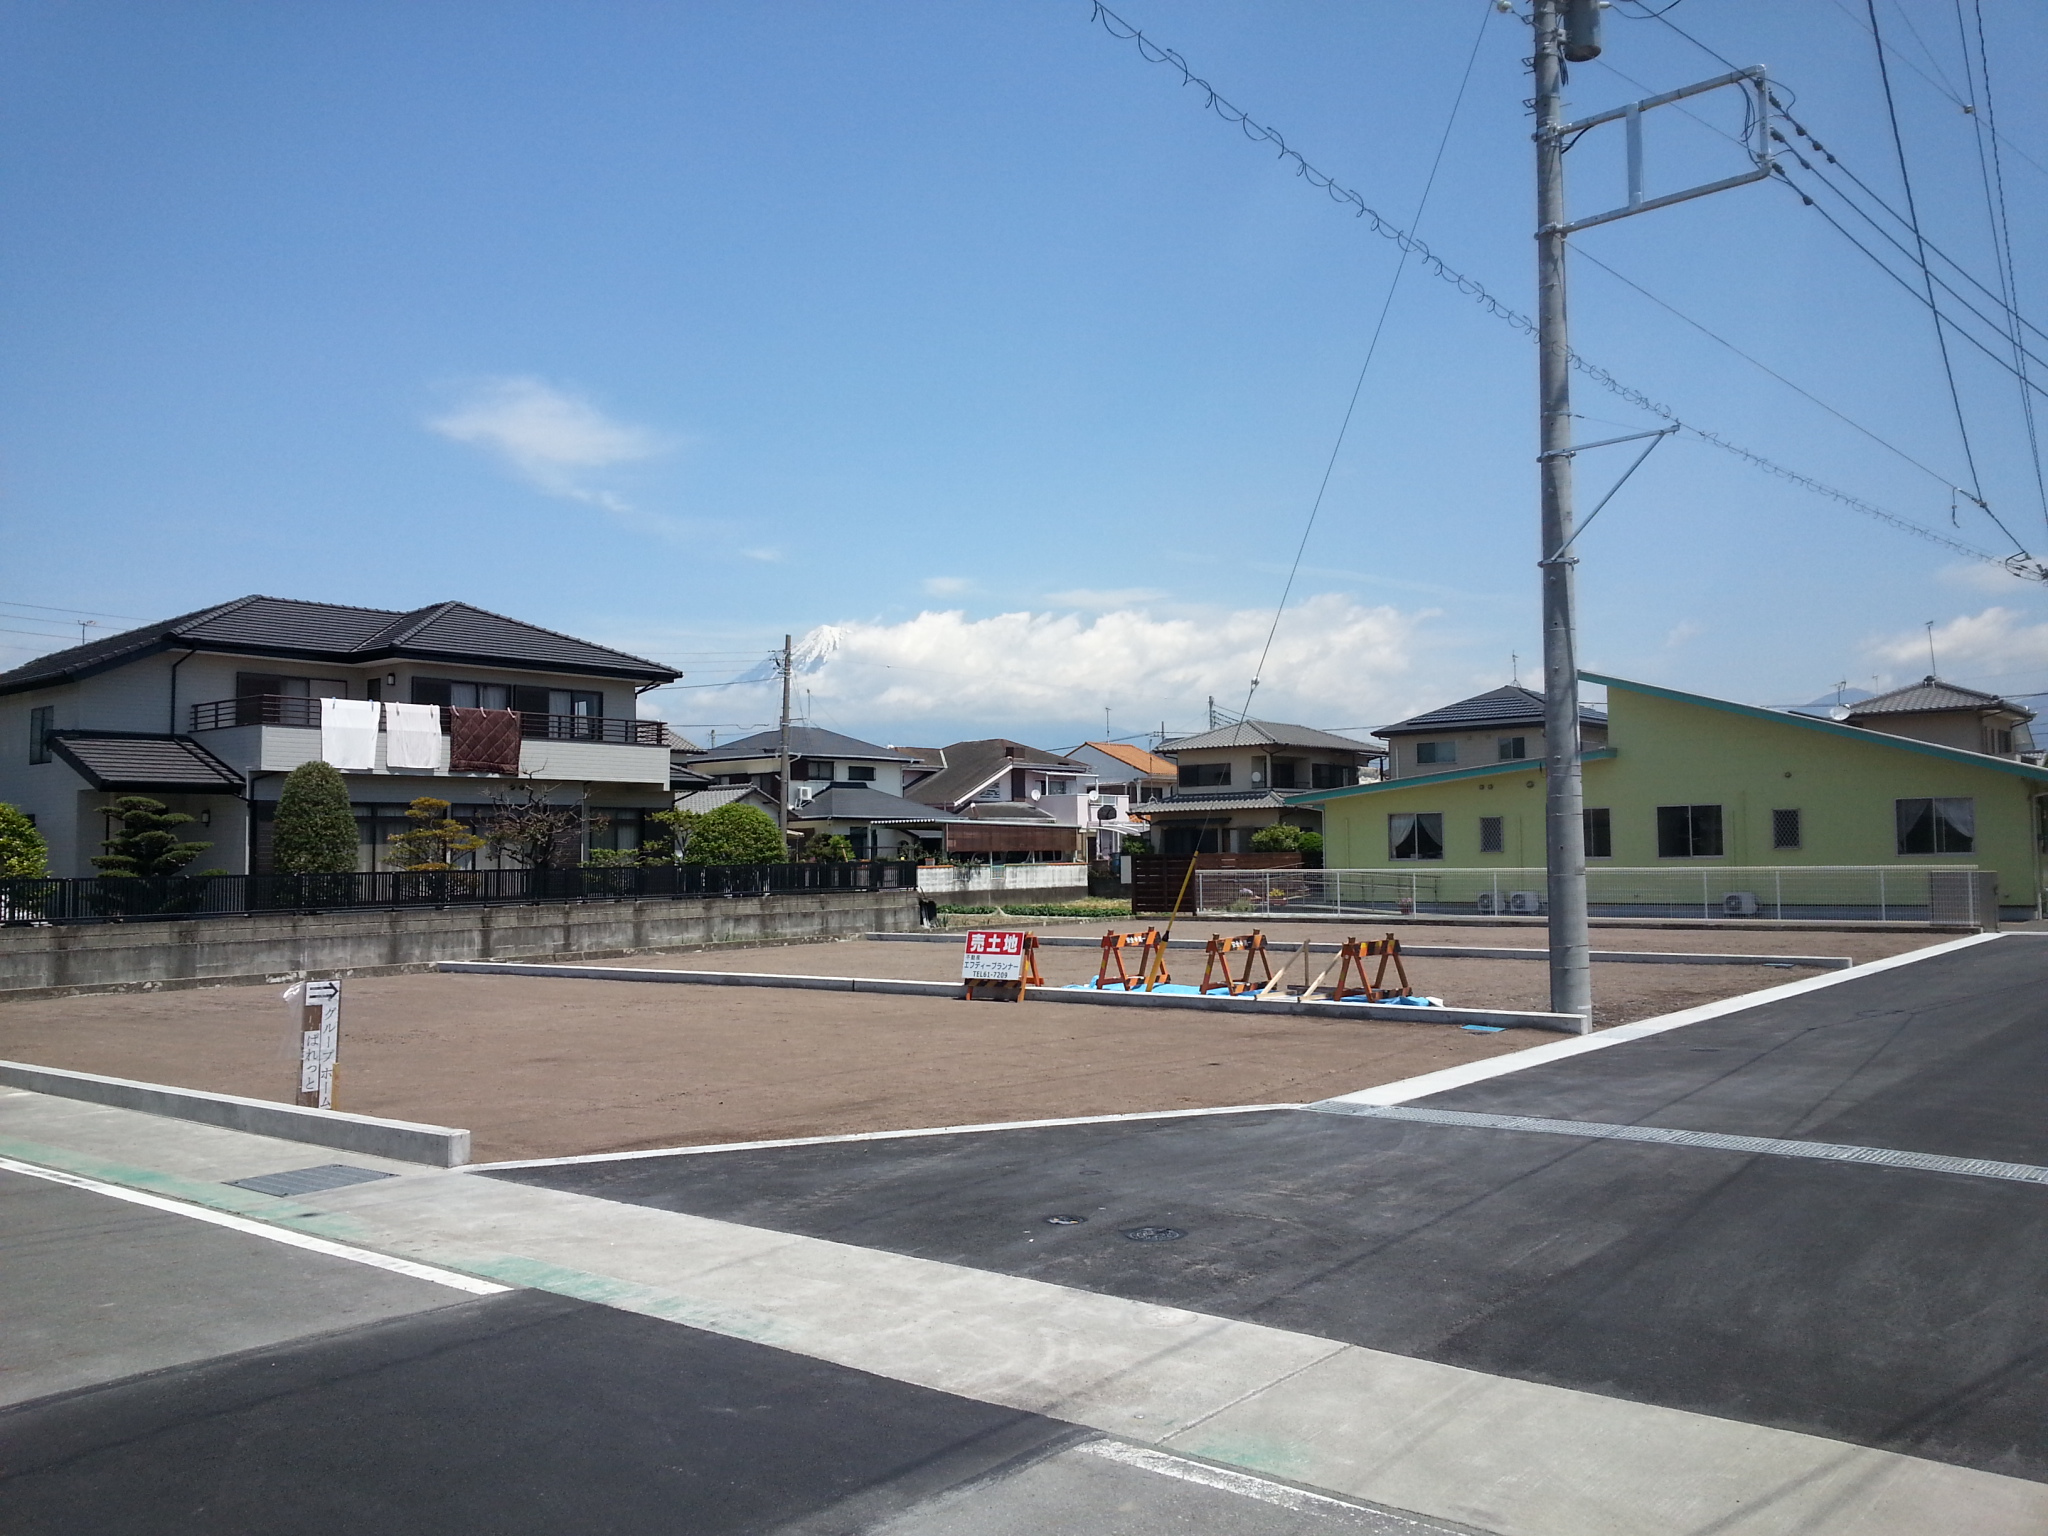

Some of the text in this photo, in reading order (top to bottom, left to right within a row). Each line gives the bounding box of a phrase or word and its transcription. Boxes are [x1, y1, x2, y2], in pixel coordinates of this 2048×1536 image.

[970, 934, 1018, 953] 売土地
[320, 1007, 337, 1108] グループホーム
